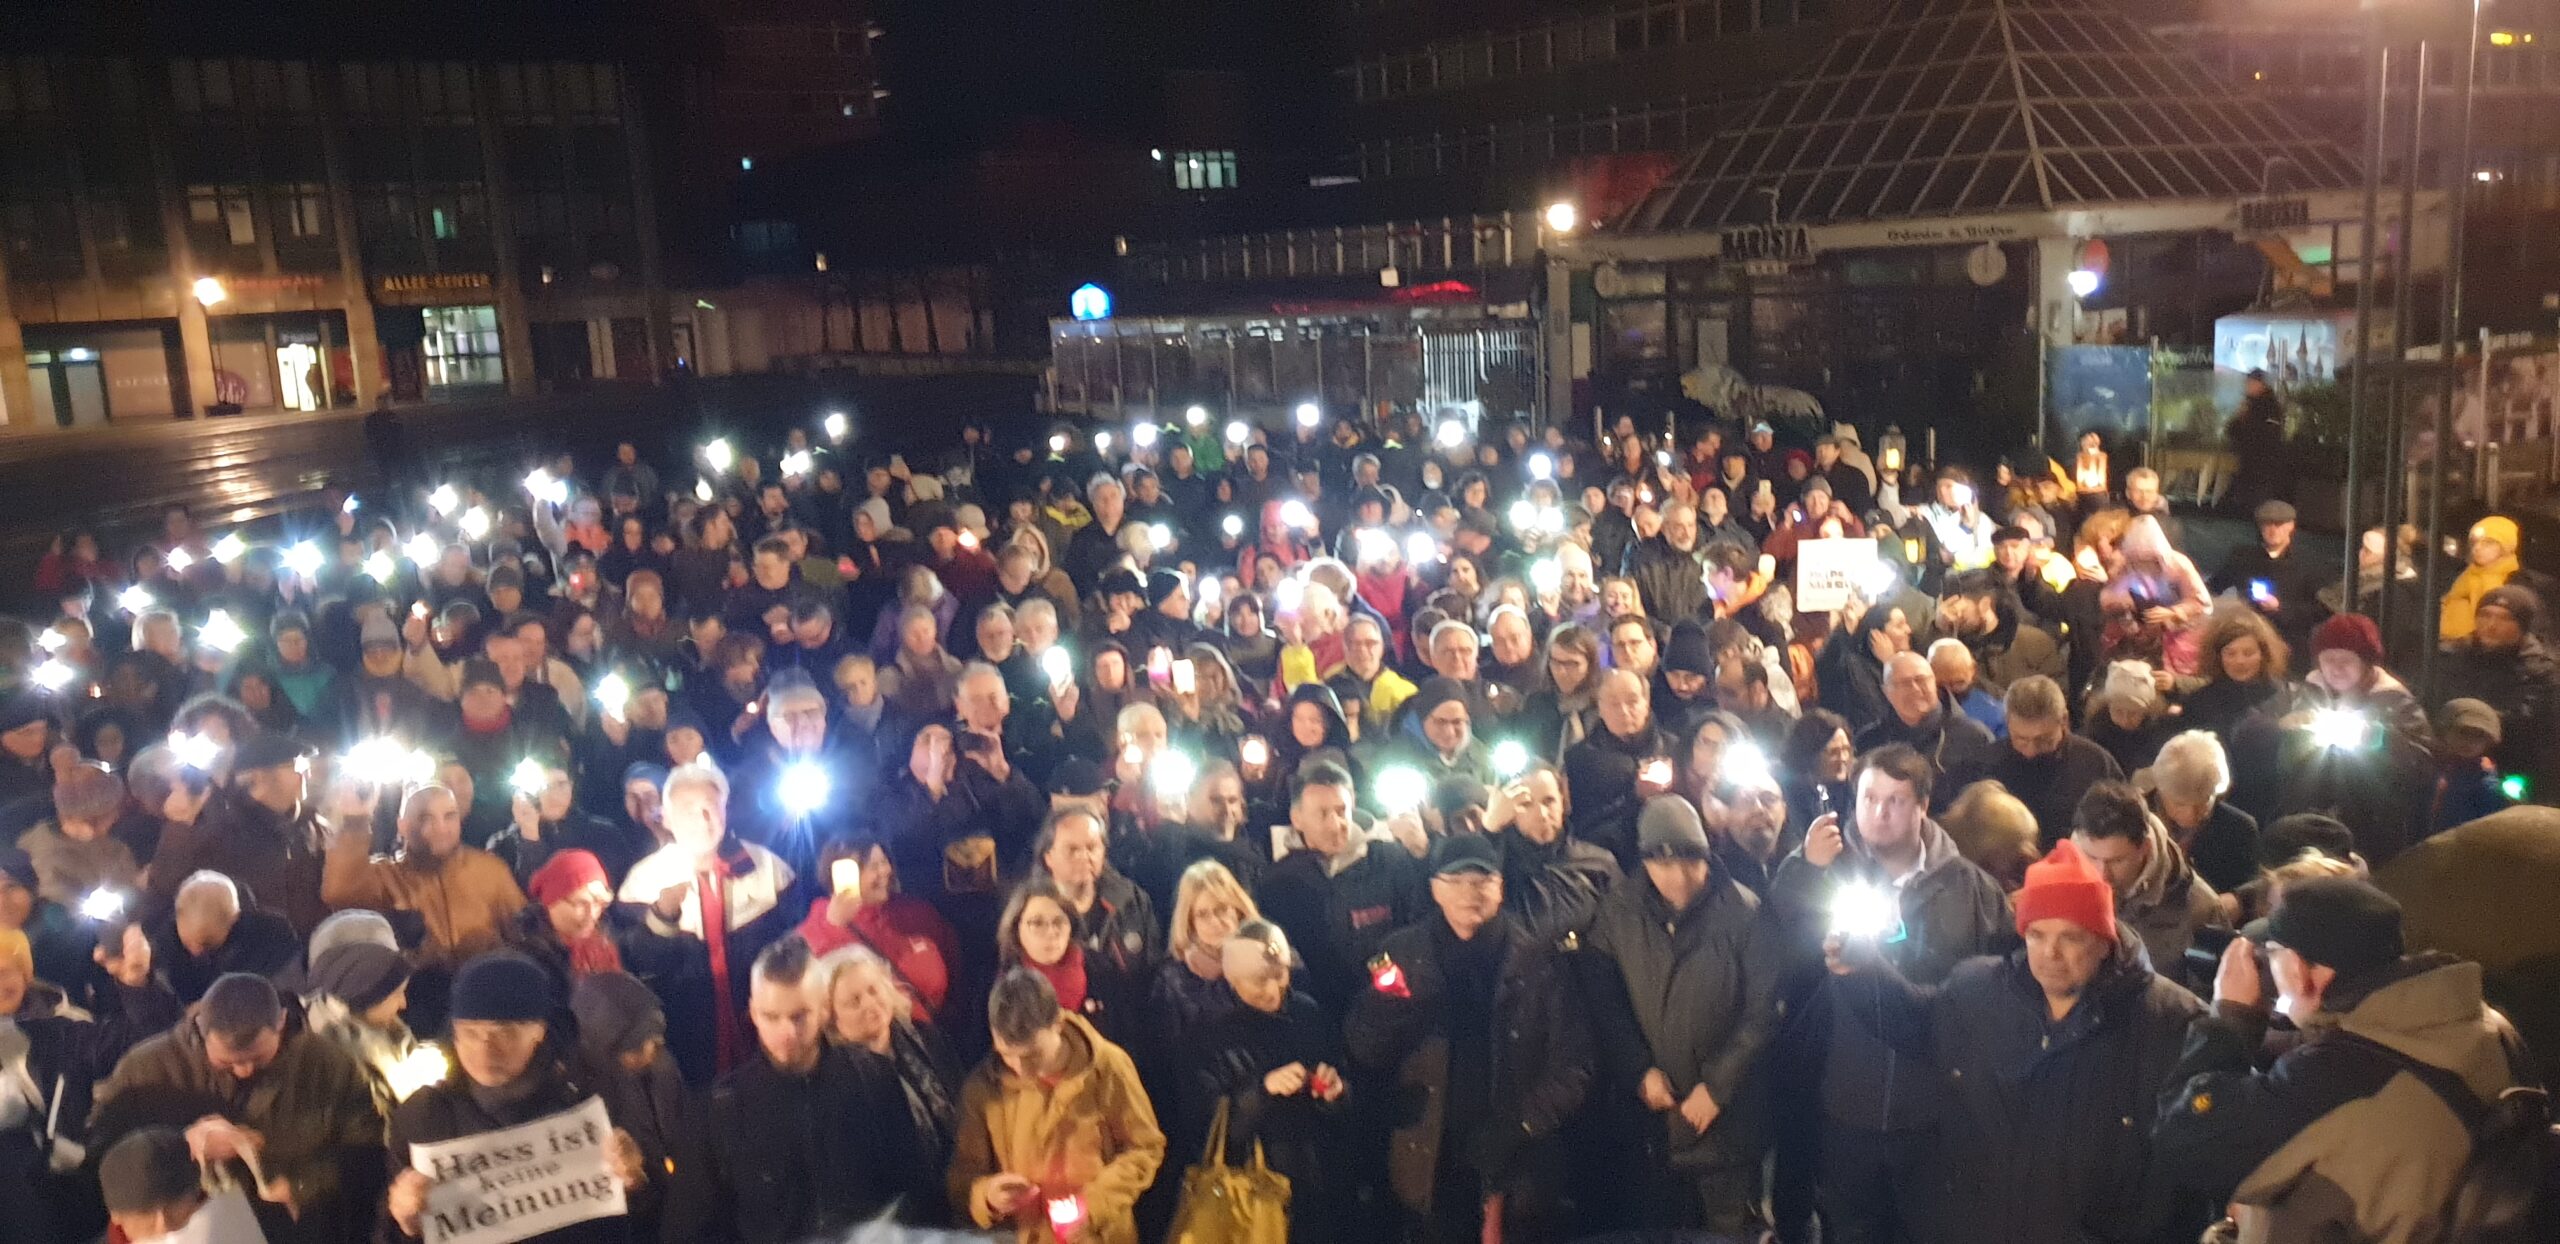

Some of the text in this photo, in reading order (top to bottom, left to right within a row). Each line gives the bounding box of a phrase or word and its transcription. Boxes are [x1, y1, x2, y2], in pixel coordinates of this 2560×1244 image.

[1722, 227, 1810, 261] BARISTA
[430, 1119, 600, 1185] Hass ist
[479, 1161, 561, 1194] keine
[433, 1172, 614, 1241] Meinung
